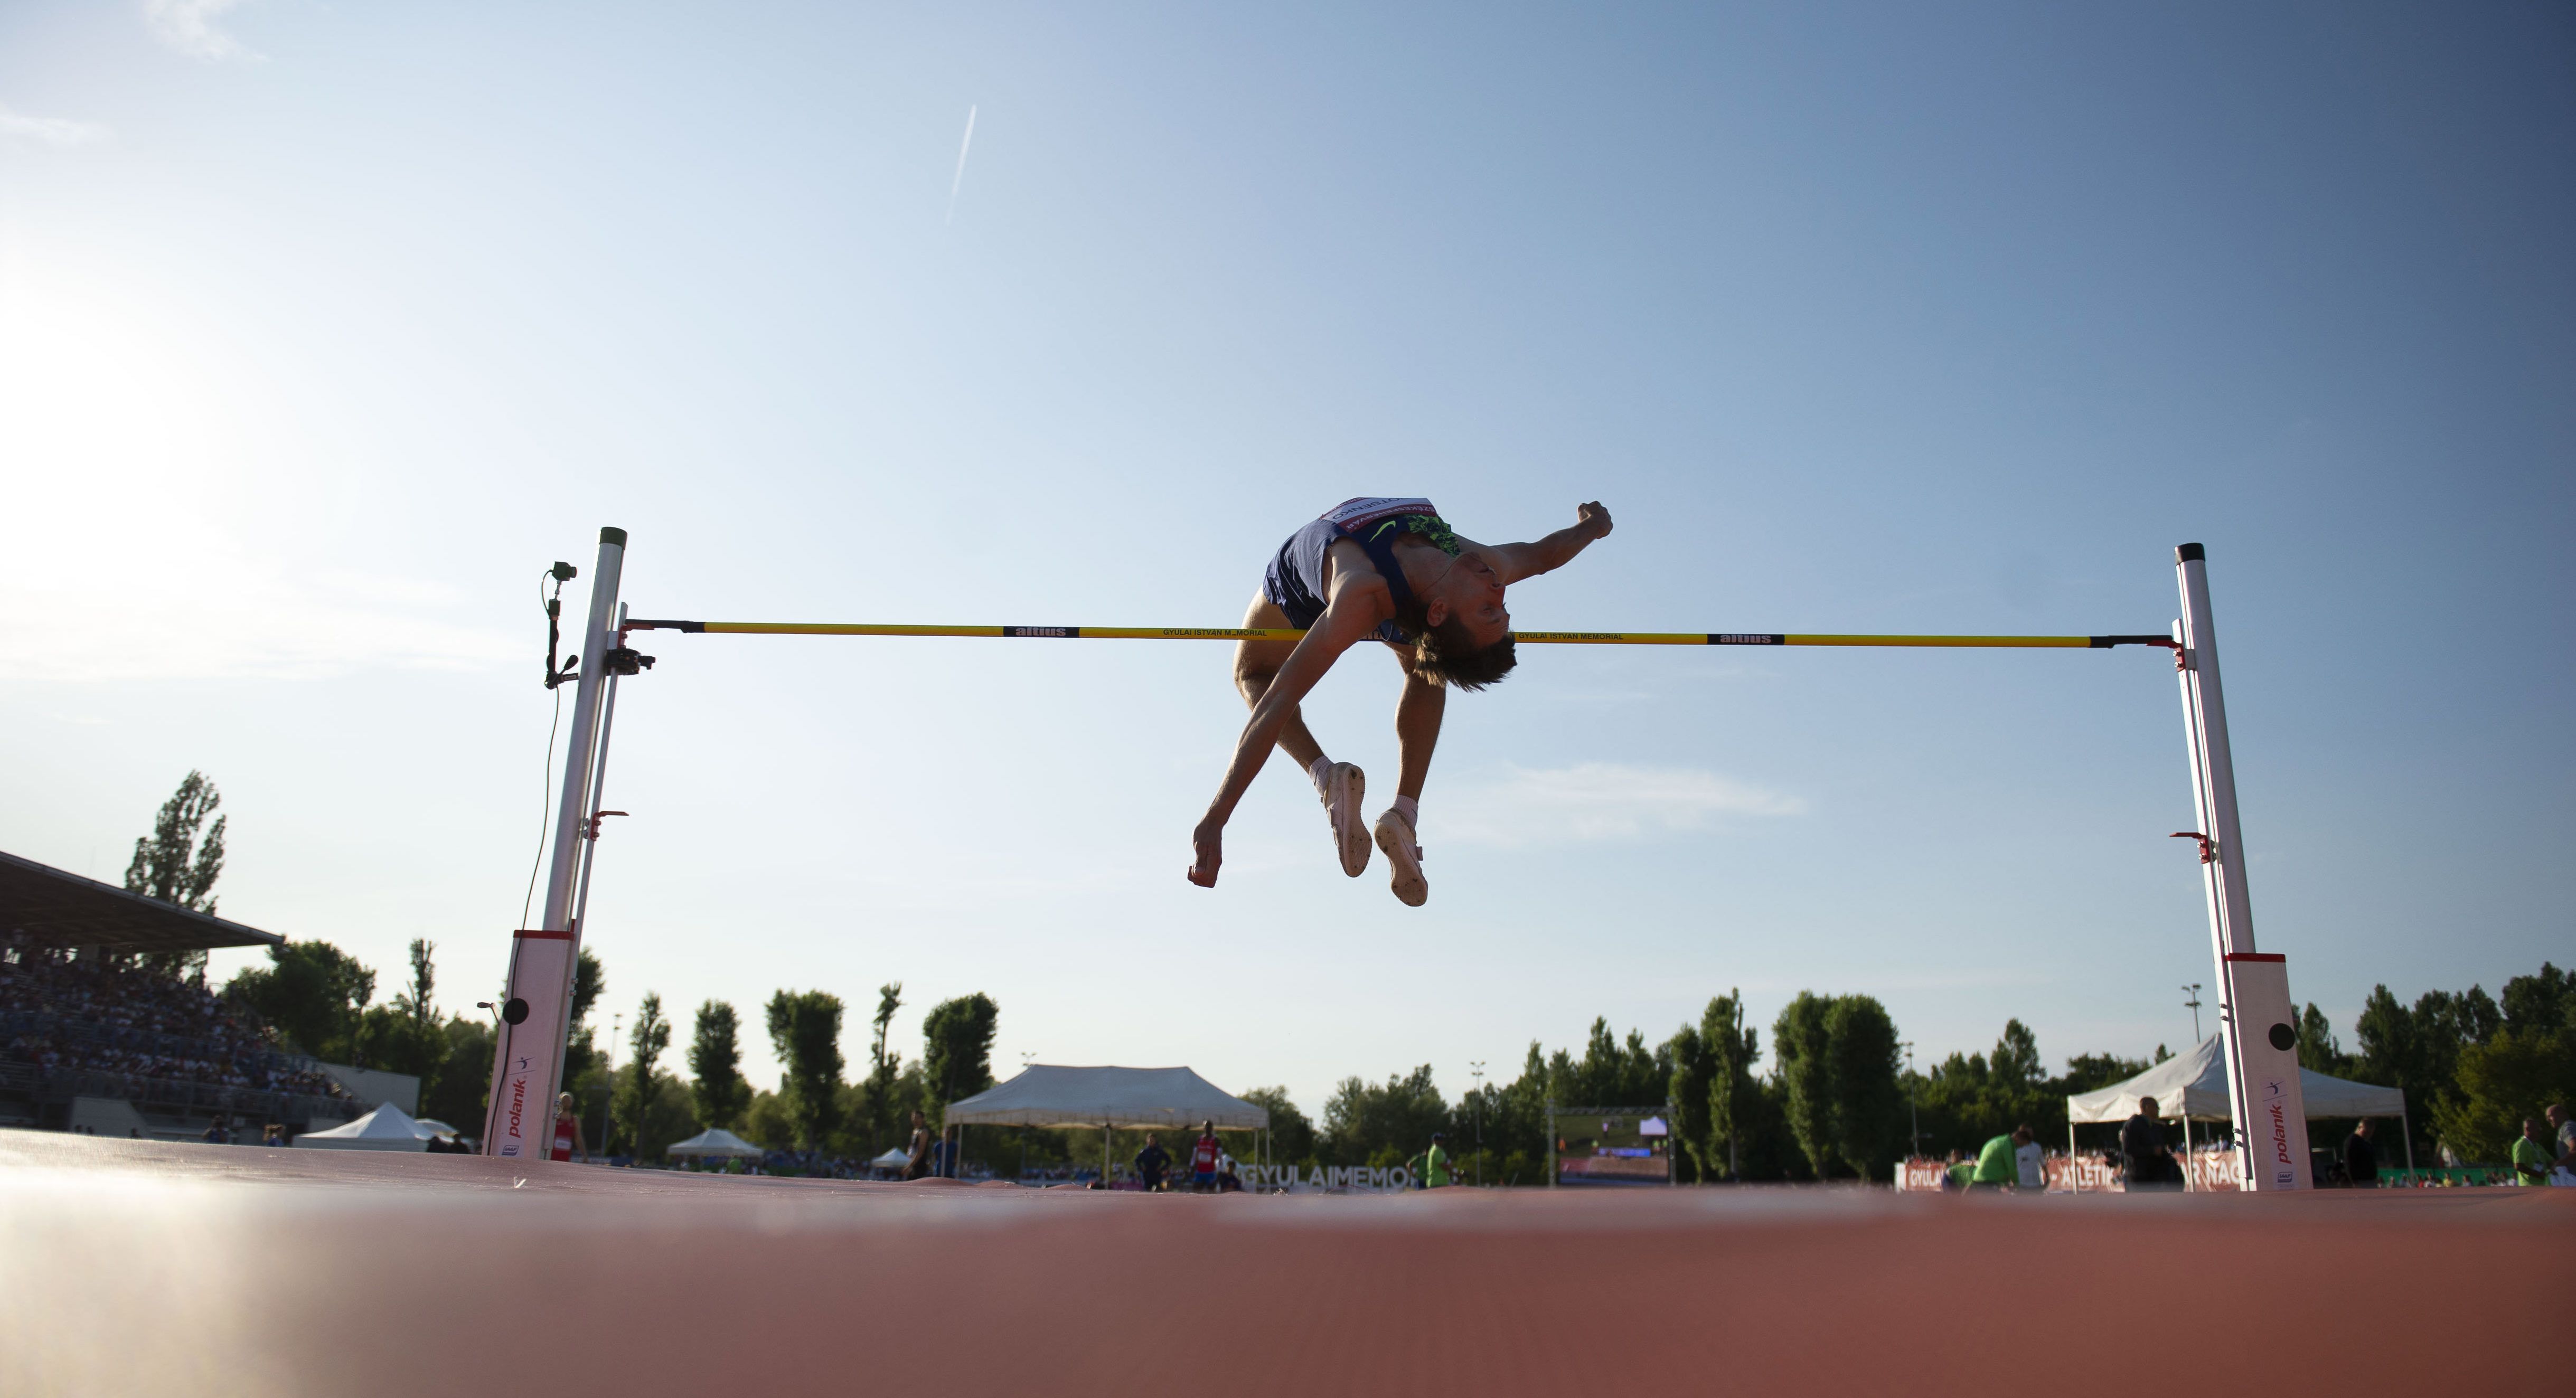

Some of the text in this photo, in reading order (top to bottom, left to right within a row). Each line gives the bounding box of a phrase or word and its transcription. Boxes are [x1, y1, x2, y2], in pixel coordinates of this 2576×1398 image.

[1332, 498, 1403, 519] OTSENKO
[1015, 627, 1066, 636] altius
[1719, 634, 1771, 644] altius
[509, 1078, 526, 1139] polanik
[2270, 1104, 2292, 1165] polanik
